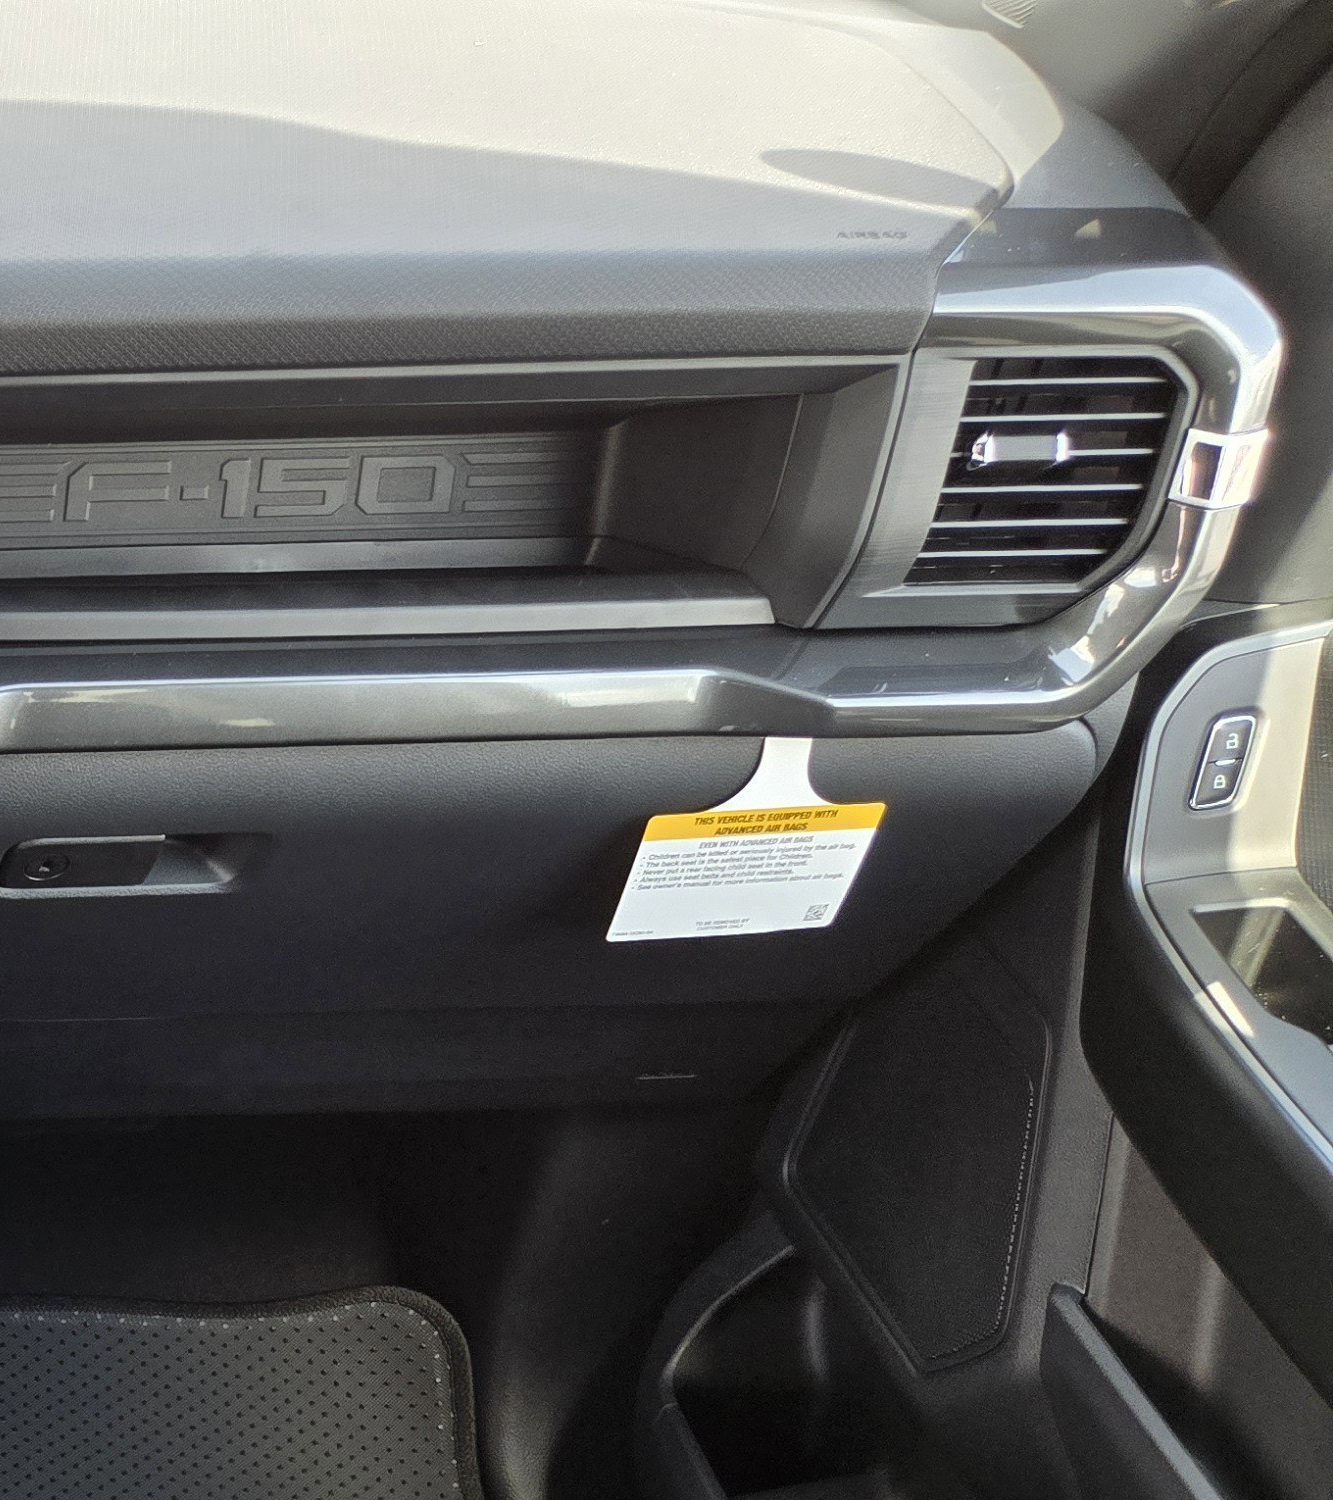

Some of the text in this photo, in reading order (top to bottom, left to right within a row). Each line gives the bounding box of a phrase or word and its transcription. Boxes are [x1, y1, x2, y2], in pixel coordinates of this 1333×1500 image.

[63, 454, 458, 523] F-150
[694, 809, 839, 826] THIS VEHICLE IS EQUIPPED WITH
[714, 822, 809, 836] ADVANCED AIR BAGS
